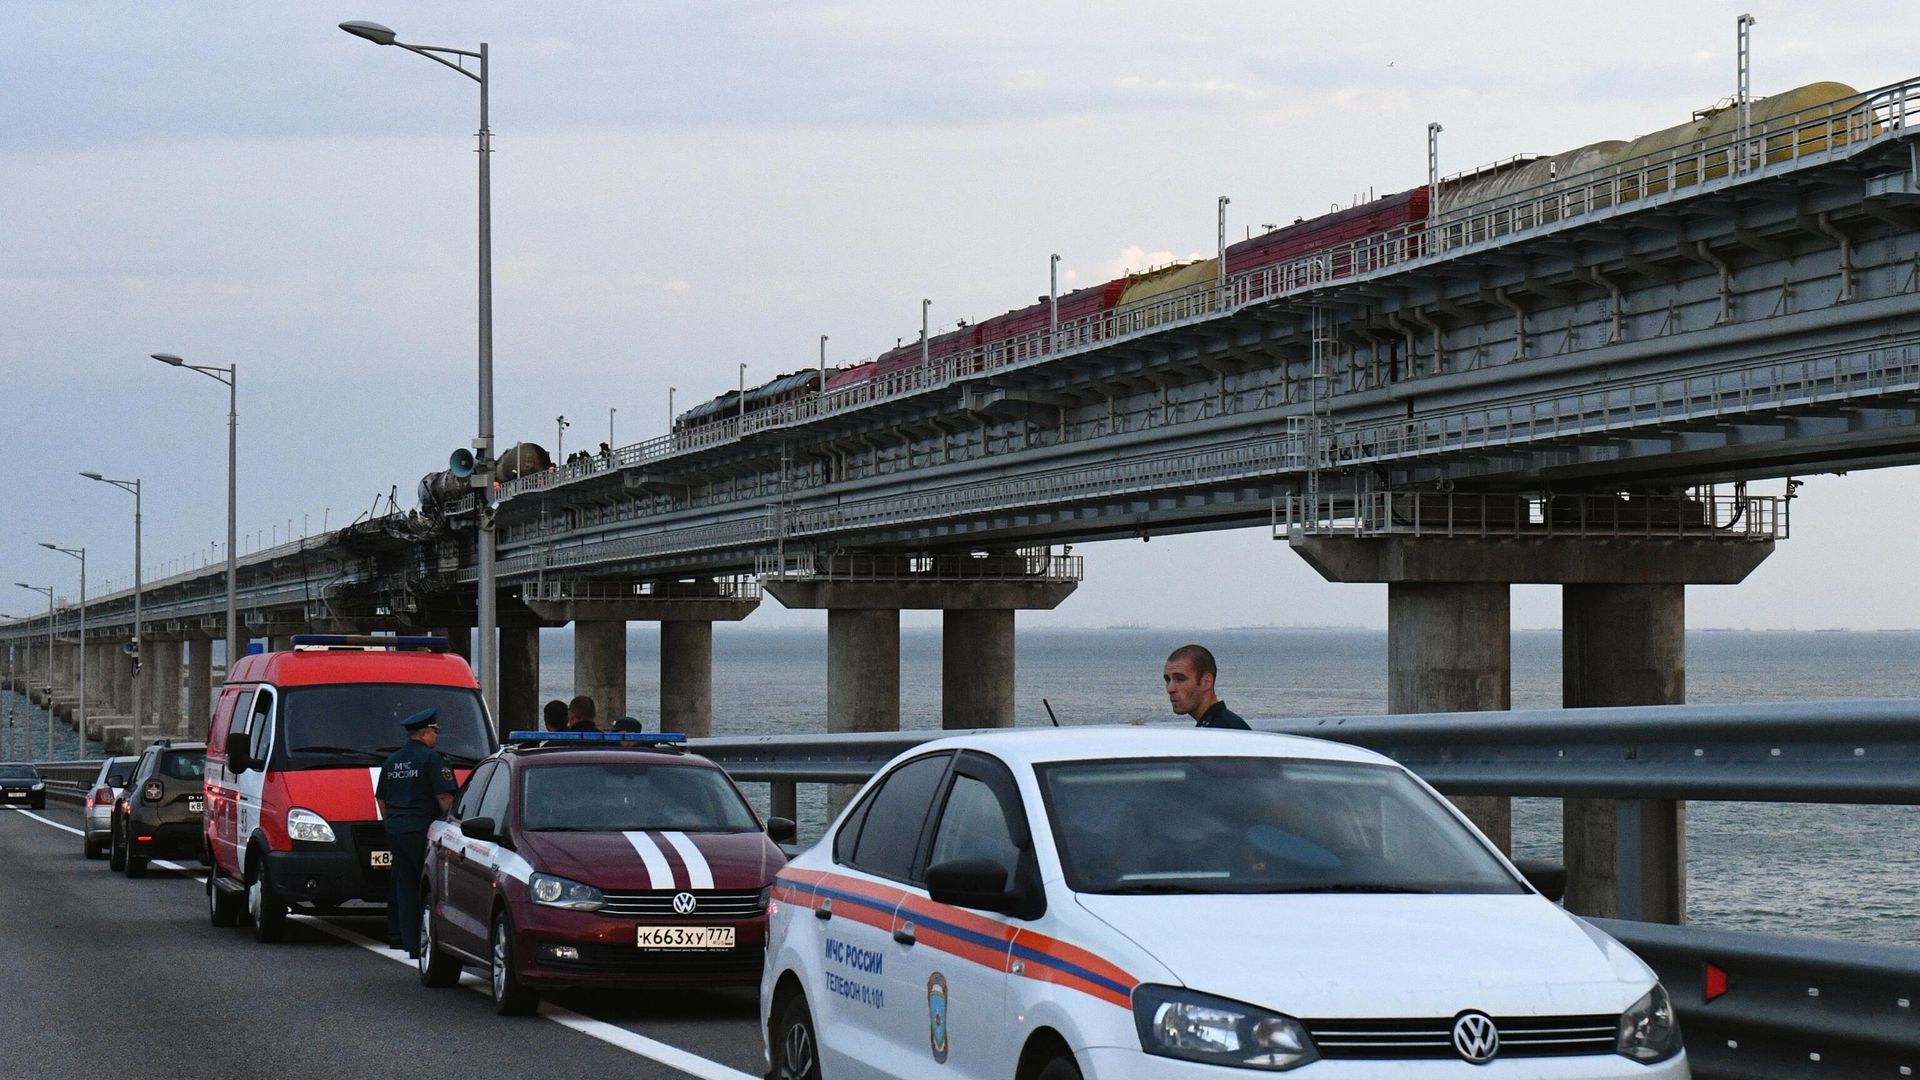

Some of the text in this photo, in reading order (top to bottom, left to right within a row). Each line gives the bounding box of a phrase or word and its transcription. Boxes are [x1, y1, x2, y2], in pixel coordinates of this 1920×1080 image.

[388, 770, 418, 779] РОССИИ
[394, 762, 412, 770] МЧС
[708, 928, 731, 941] 777
[826, 938, 883, 975] МЧС РОССИИ
[826, 971, 861, 1001] ТЕЛЕФОН
[1454, 1014, 1499, 1060] VW
